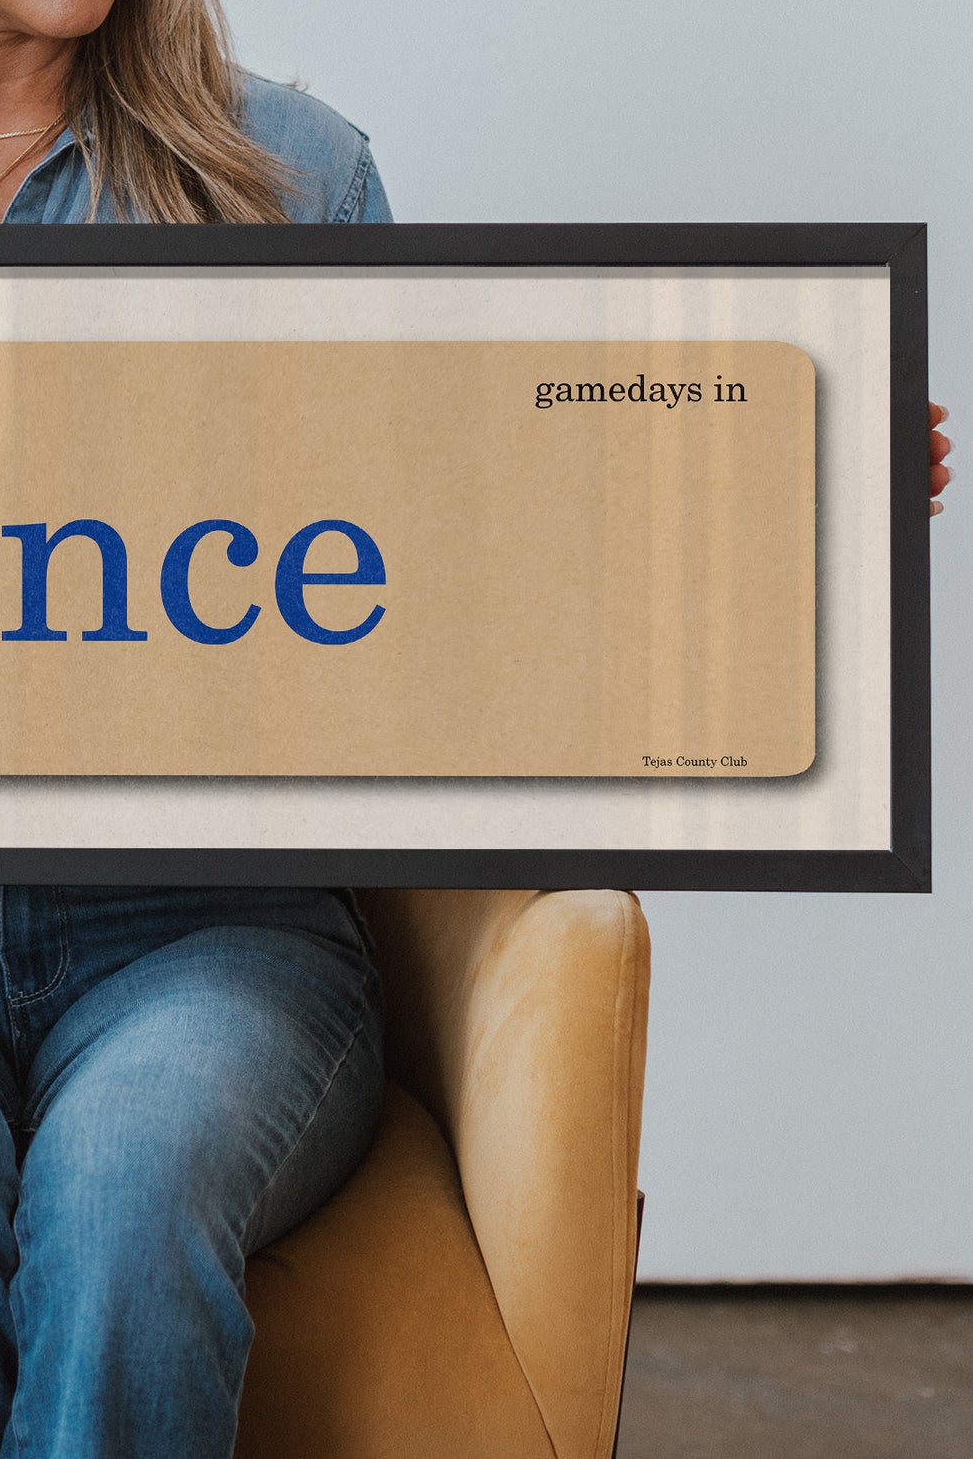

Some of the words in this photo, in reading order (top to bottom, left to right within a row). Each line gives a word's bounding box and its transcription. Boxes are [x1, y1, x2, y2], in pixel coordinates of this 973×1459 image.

[535, 374, 703, 410] gamedays
[714, 374, 748, 402] in
[641, 755, 673, 768] Tejas
[676, 755, 717, 768] County
[720, 755, 748, 767] Club
